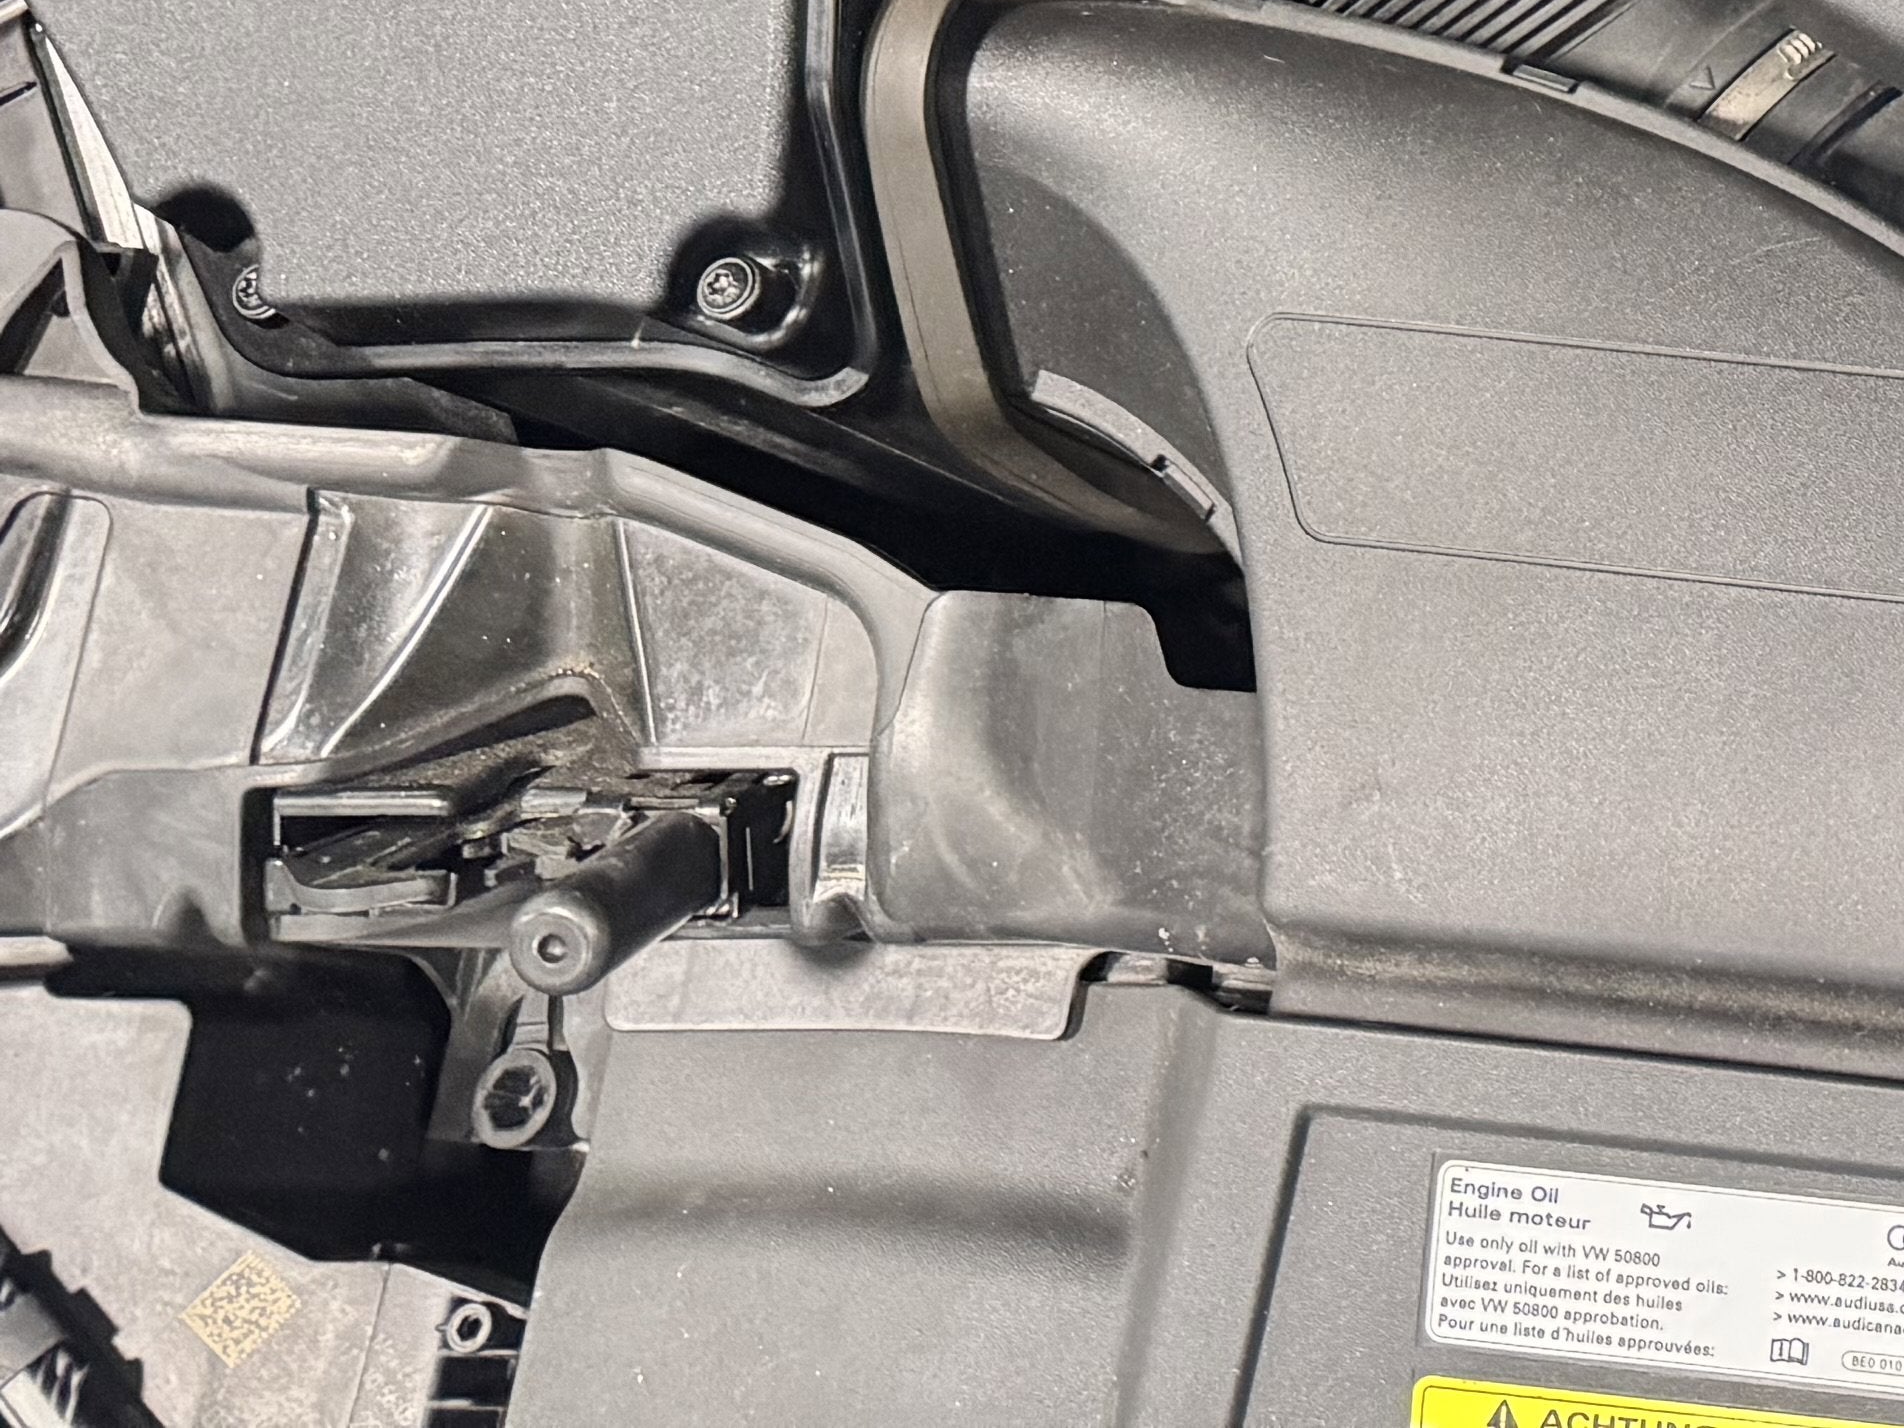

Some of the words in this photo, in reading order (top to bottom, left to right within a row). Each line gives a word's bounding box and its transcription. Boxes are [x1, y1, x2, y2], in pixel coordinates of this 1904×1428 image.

[1449, 1177, 1523, 1203] Engine
[1531, 1185, 1559, 1203] Oil
[1448, 1201, 1502, 1221] Huile
[1509, 1208, 1591, 1230] moteur
[1445, 1231, 1474, 1248] Use
[1479, 1234, 1514, 1254] only
[1519, 1238, 1538, 1254] oil
[1542, 1240, 1576, 1258] with
[1581, 1246, 1609, 1261] VW
[1613, 1248, 1660, 1267] 50800
[1441, 1272, 1499, 1292] Utilisez
[1503, 1278, 1598, 1306] uniquement
[1603, 1288, 1630, 1306] des
[1635, 1292, 1683, 1311] huiles
[1443, 1253, 1516, 1275] approval.
[1521, 1259, 1548, 1276] For
[1552, 1266, 1561, 1277] a
[1566, 1264, 1590, 1281] list
[1594, 1266, 1611, 1283] of
[1615, 1269, 1691, 1294] approved
[1695, 1279, 1729, 1295] oils:
[1439, 1295, 1476, 1310] avec
[1479, 1297, 1508, 1313] VW
[1512, 1301, 1559, 1319] 50800
[1563, 1306, 1665, 1334] approbation.
[1437, 1314, 1474, 1331] Pour
[1479, 1321, 1508, 1334] une
[1513, 1321, 1545, 1339] liste
[1617, 1333, 1716, 1359] approuvées:
[1879, 1358, 1902, 1371] 010
